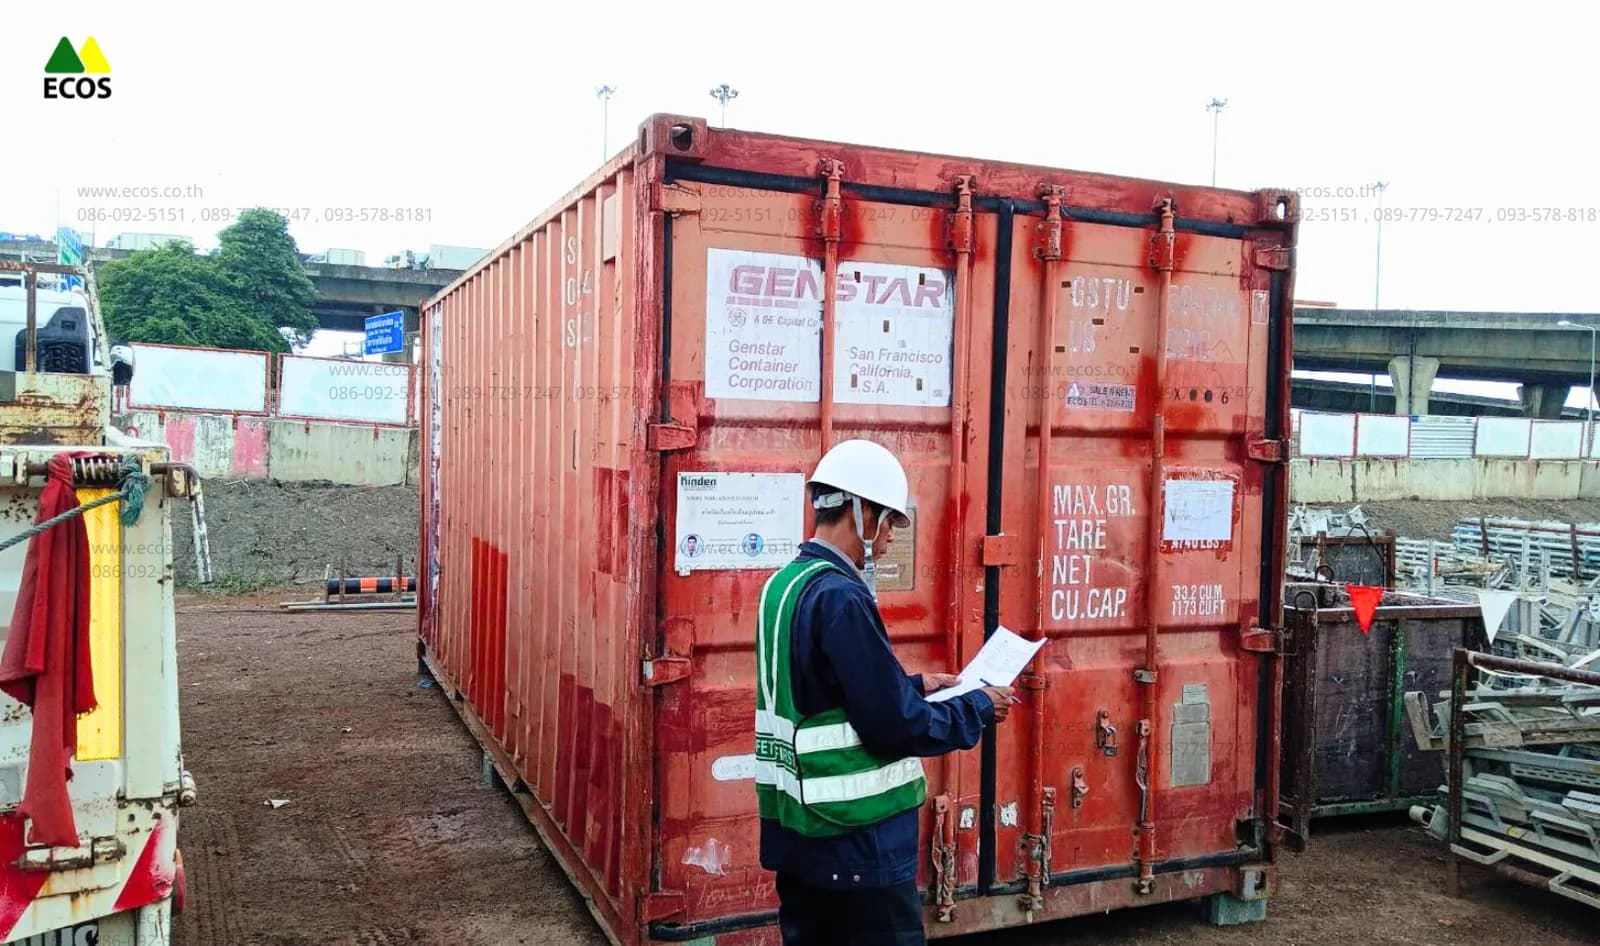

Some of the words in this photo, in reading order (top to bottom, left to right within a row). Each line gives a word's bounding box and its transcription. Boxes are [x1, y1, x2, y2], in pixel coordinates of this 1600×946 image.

[728, 264, 946, 309] GENSTAR
[1071, 275, 1131, 311] GSTU
[728, 338, 787, 357] Genstar
[849, 345, 874, 361] San
[878, 347, 943, 365] Francisco
[728, 357, 799, 375] Container
[728, 374, 813, 393] Corporation
[1053, 518, 1107, 550] TARE
[1052, 554, 1091, 586] NET
